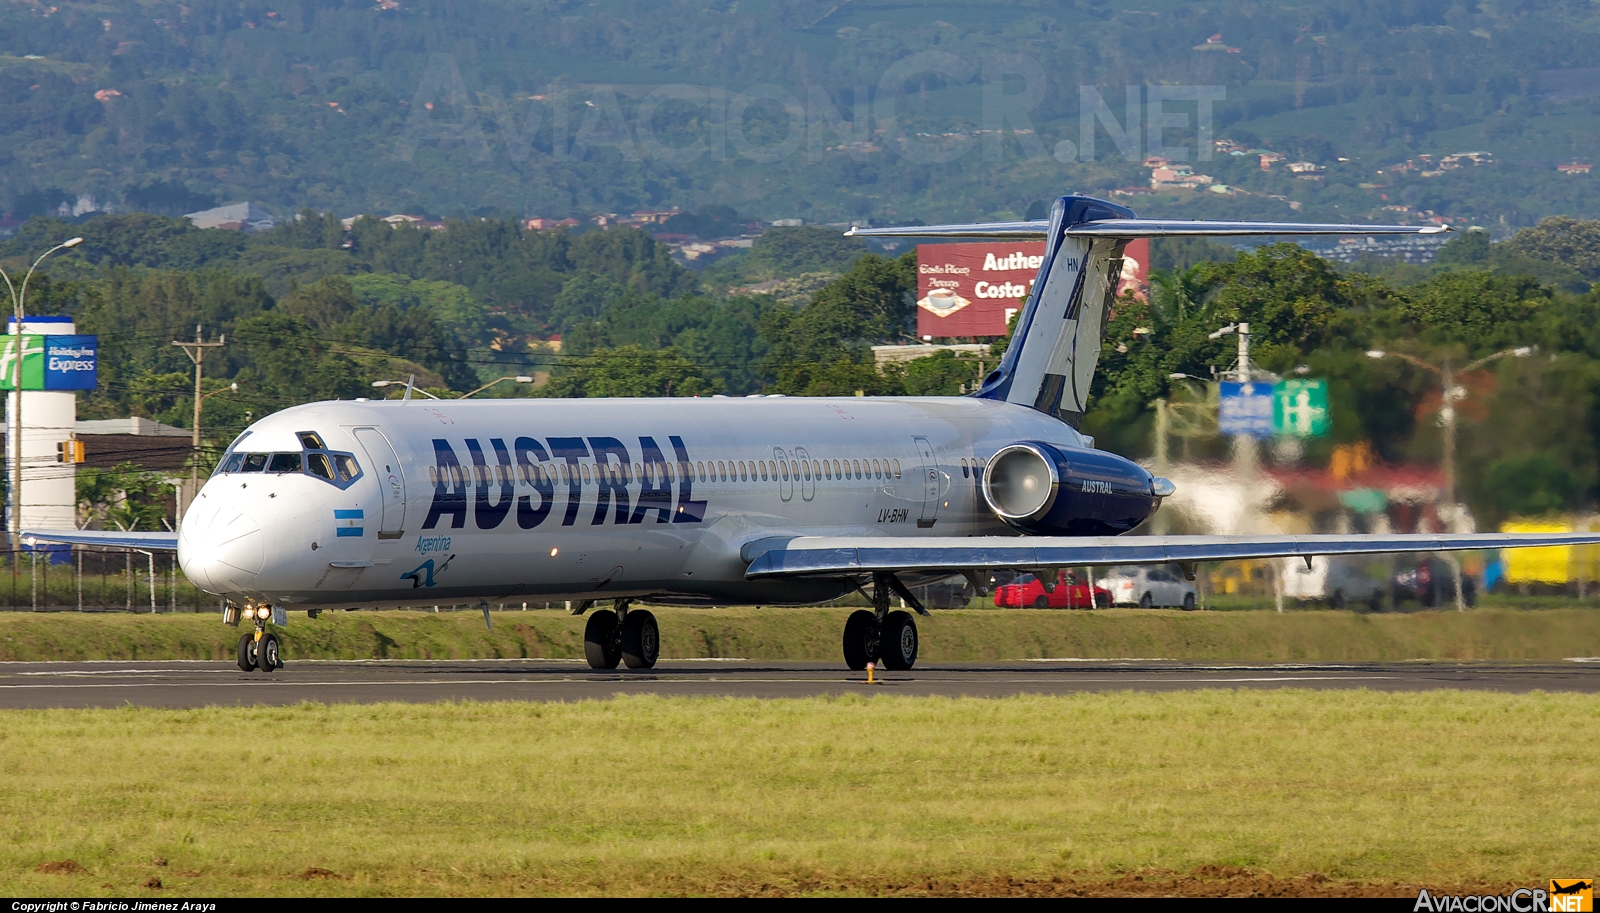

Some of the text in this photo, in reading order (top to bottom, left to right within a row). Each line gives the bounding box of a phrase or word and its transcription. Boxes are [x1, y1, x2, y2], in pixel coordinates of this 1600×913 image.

[1066, 257, 1079, 272] HN
[974, 280, 1026, 299] Costa
[48, 346, 81, 358] Holiday
[48, 357, 95, 373] Express
[421, 436, 709, 530] AUSTRAL
[1081, 479, 1113, 495] AUSTRAL
[877, 508, 910, 523] LV-BHN
[414, 534, 452, 556] Argentina
